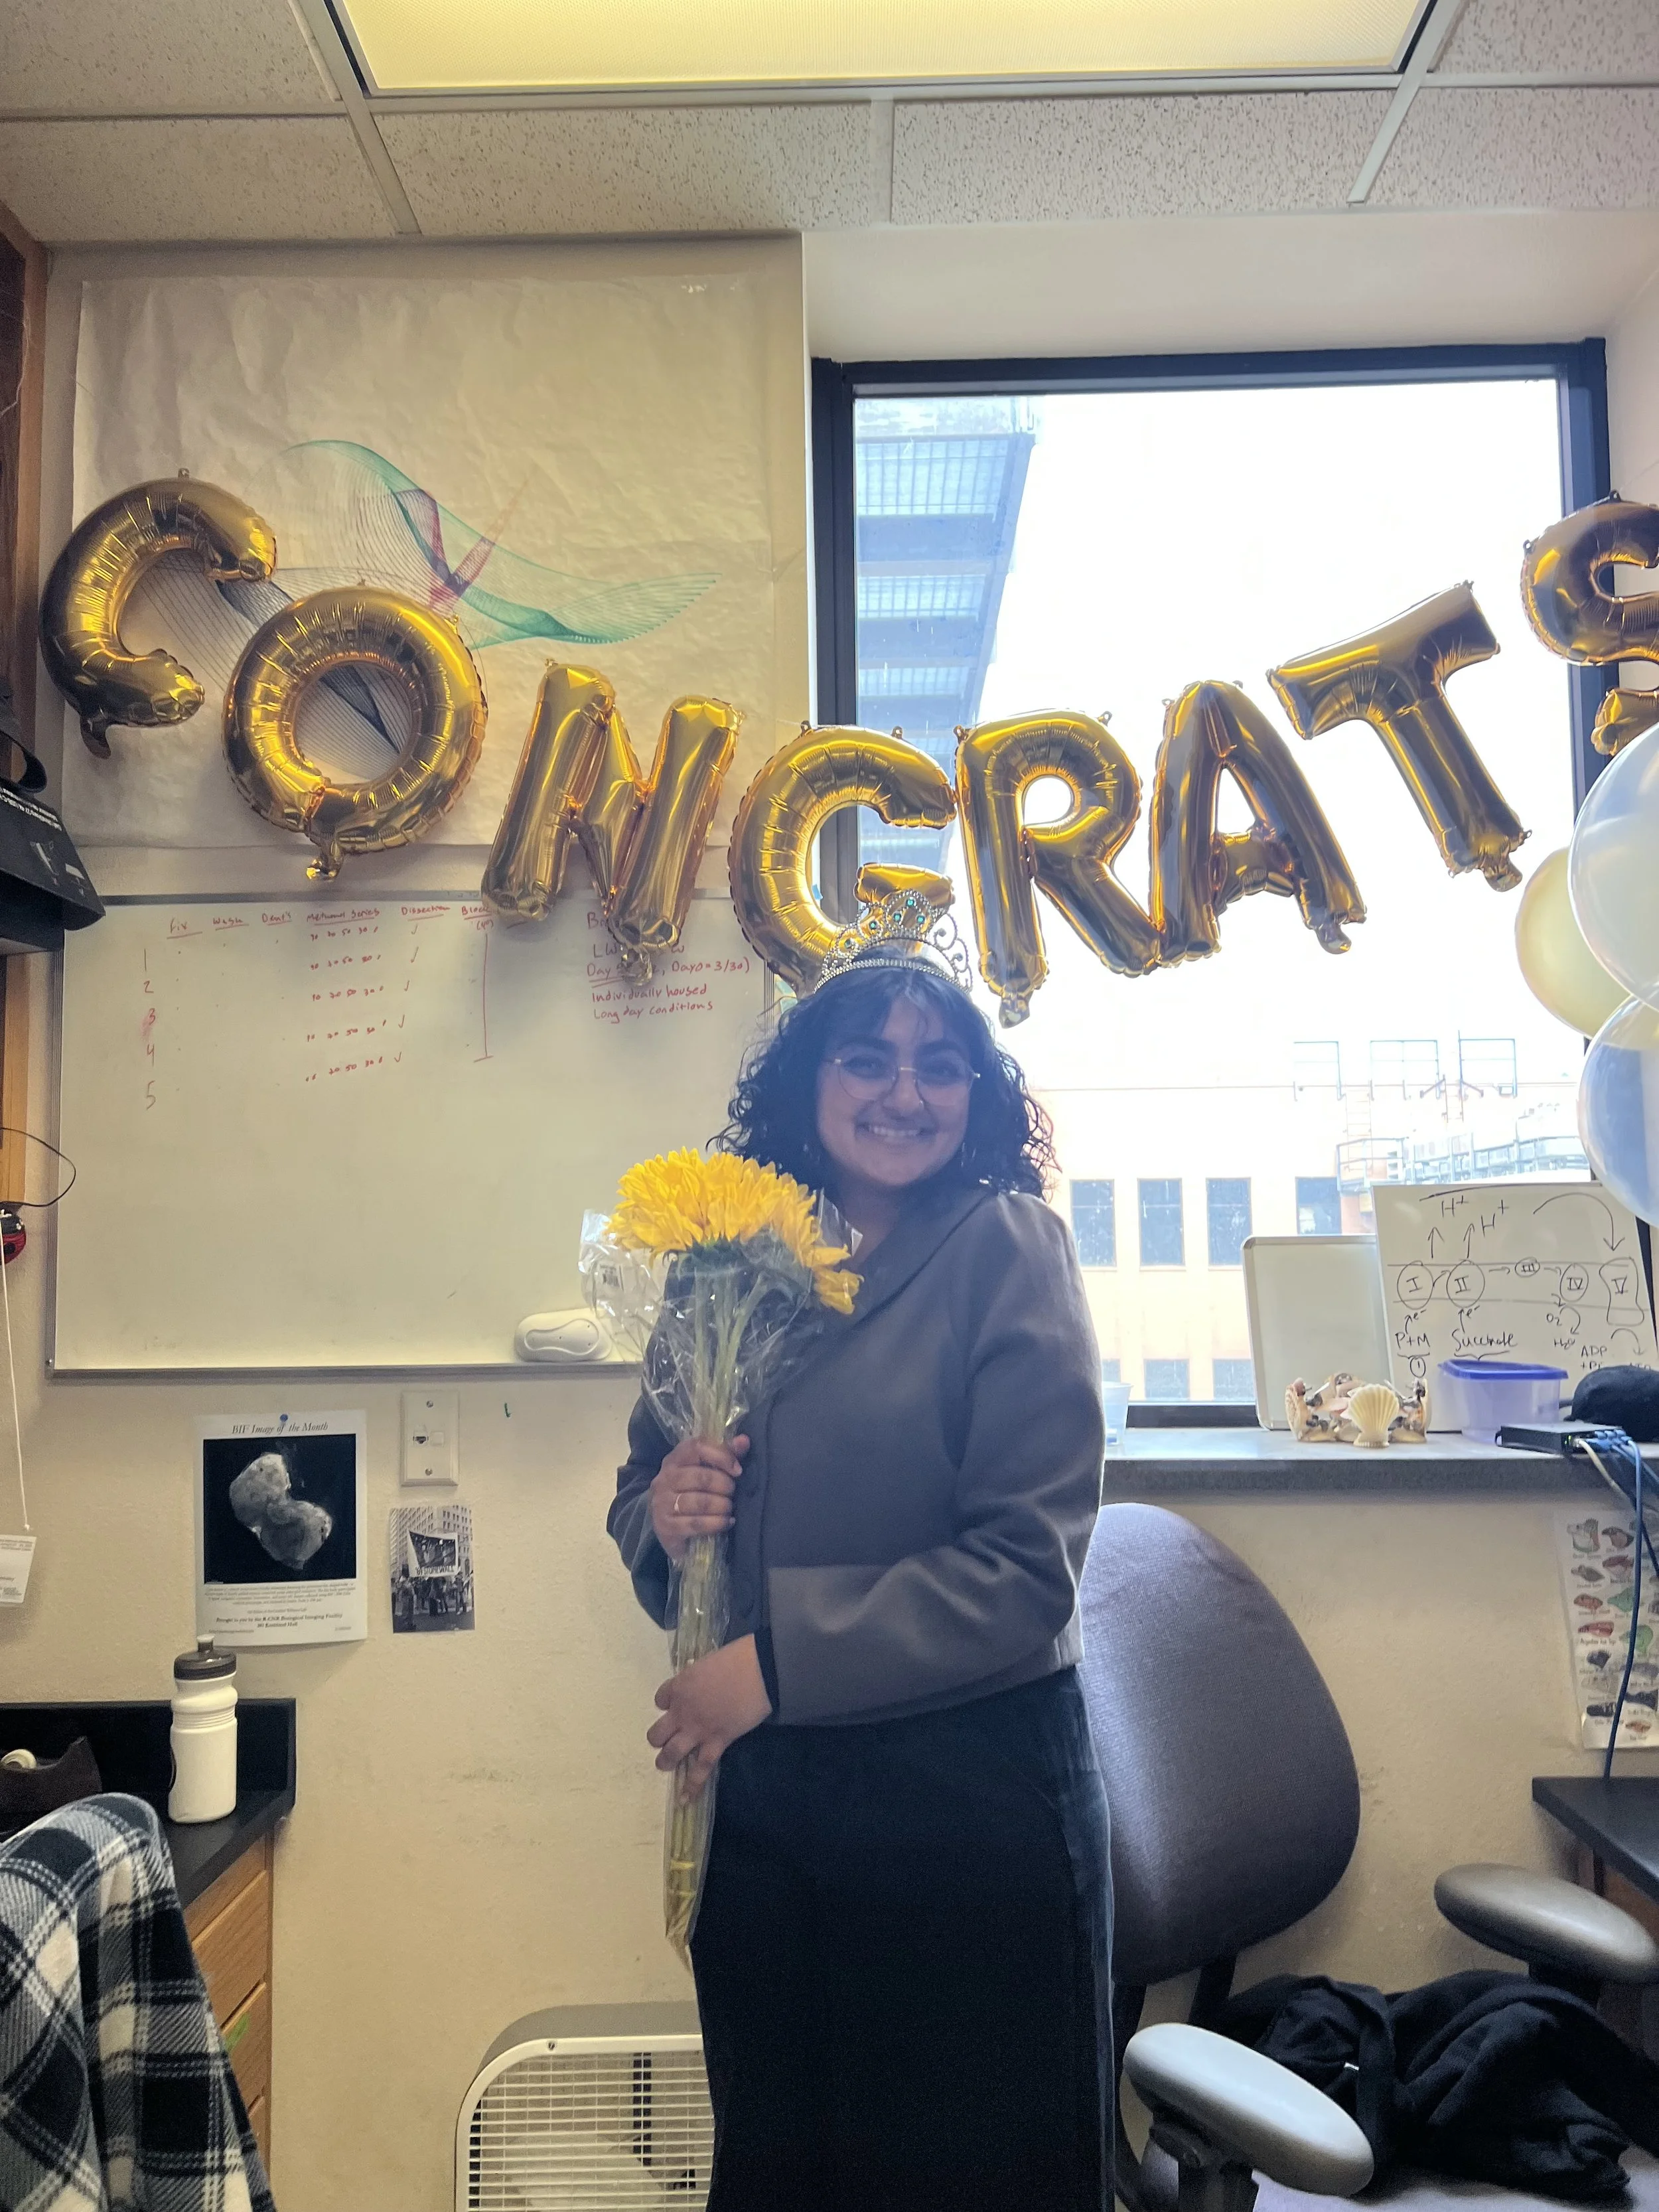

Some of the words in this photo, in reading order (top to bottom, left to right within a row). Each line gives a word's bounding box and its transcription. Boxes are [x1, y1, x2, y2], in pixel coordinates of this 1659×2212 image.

[587, 962, 611, 979] Day
[143, 980, 155, 994] 2
[592, 987, 662, 1003] Individually
[666, 982, 707, 997] housed
[148, 1007, 156, 1026] 3
[594, 1008, 620, 1024] Long
[623, 1005, 644, 1019] day
[146, 1043, 155, 1068] 4
[146, 1080, 157, 1111] 5
[1454, 1276, 1471, 1295] II
[1565, 1276, 1584, 1293] IV
[1581, 1344, 1608, 1359] ADP
[251, 1424, 275, 1436] Image
[276, 1424, 285, 1435] of
[288, 1422, 299, 1432] the
[301, 1421, 329, 1432] Month
